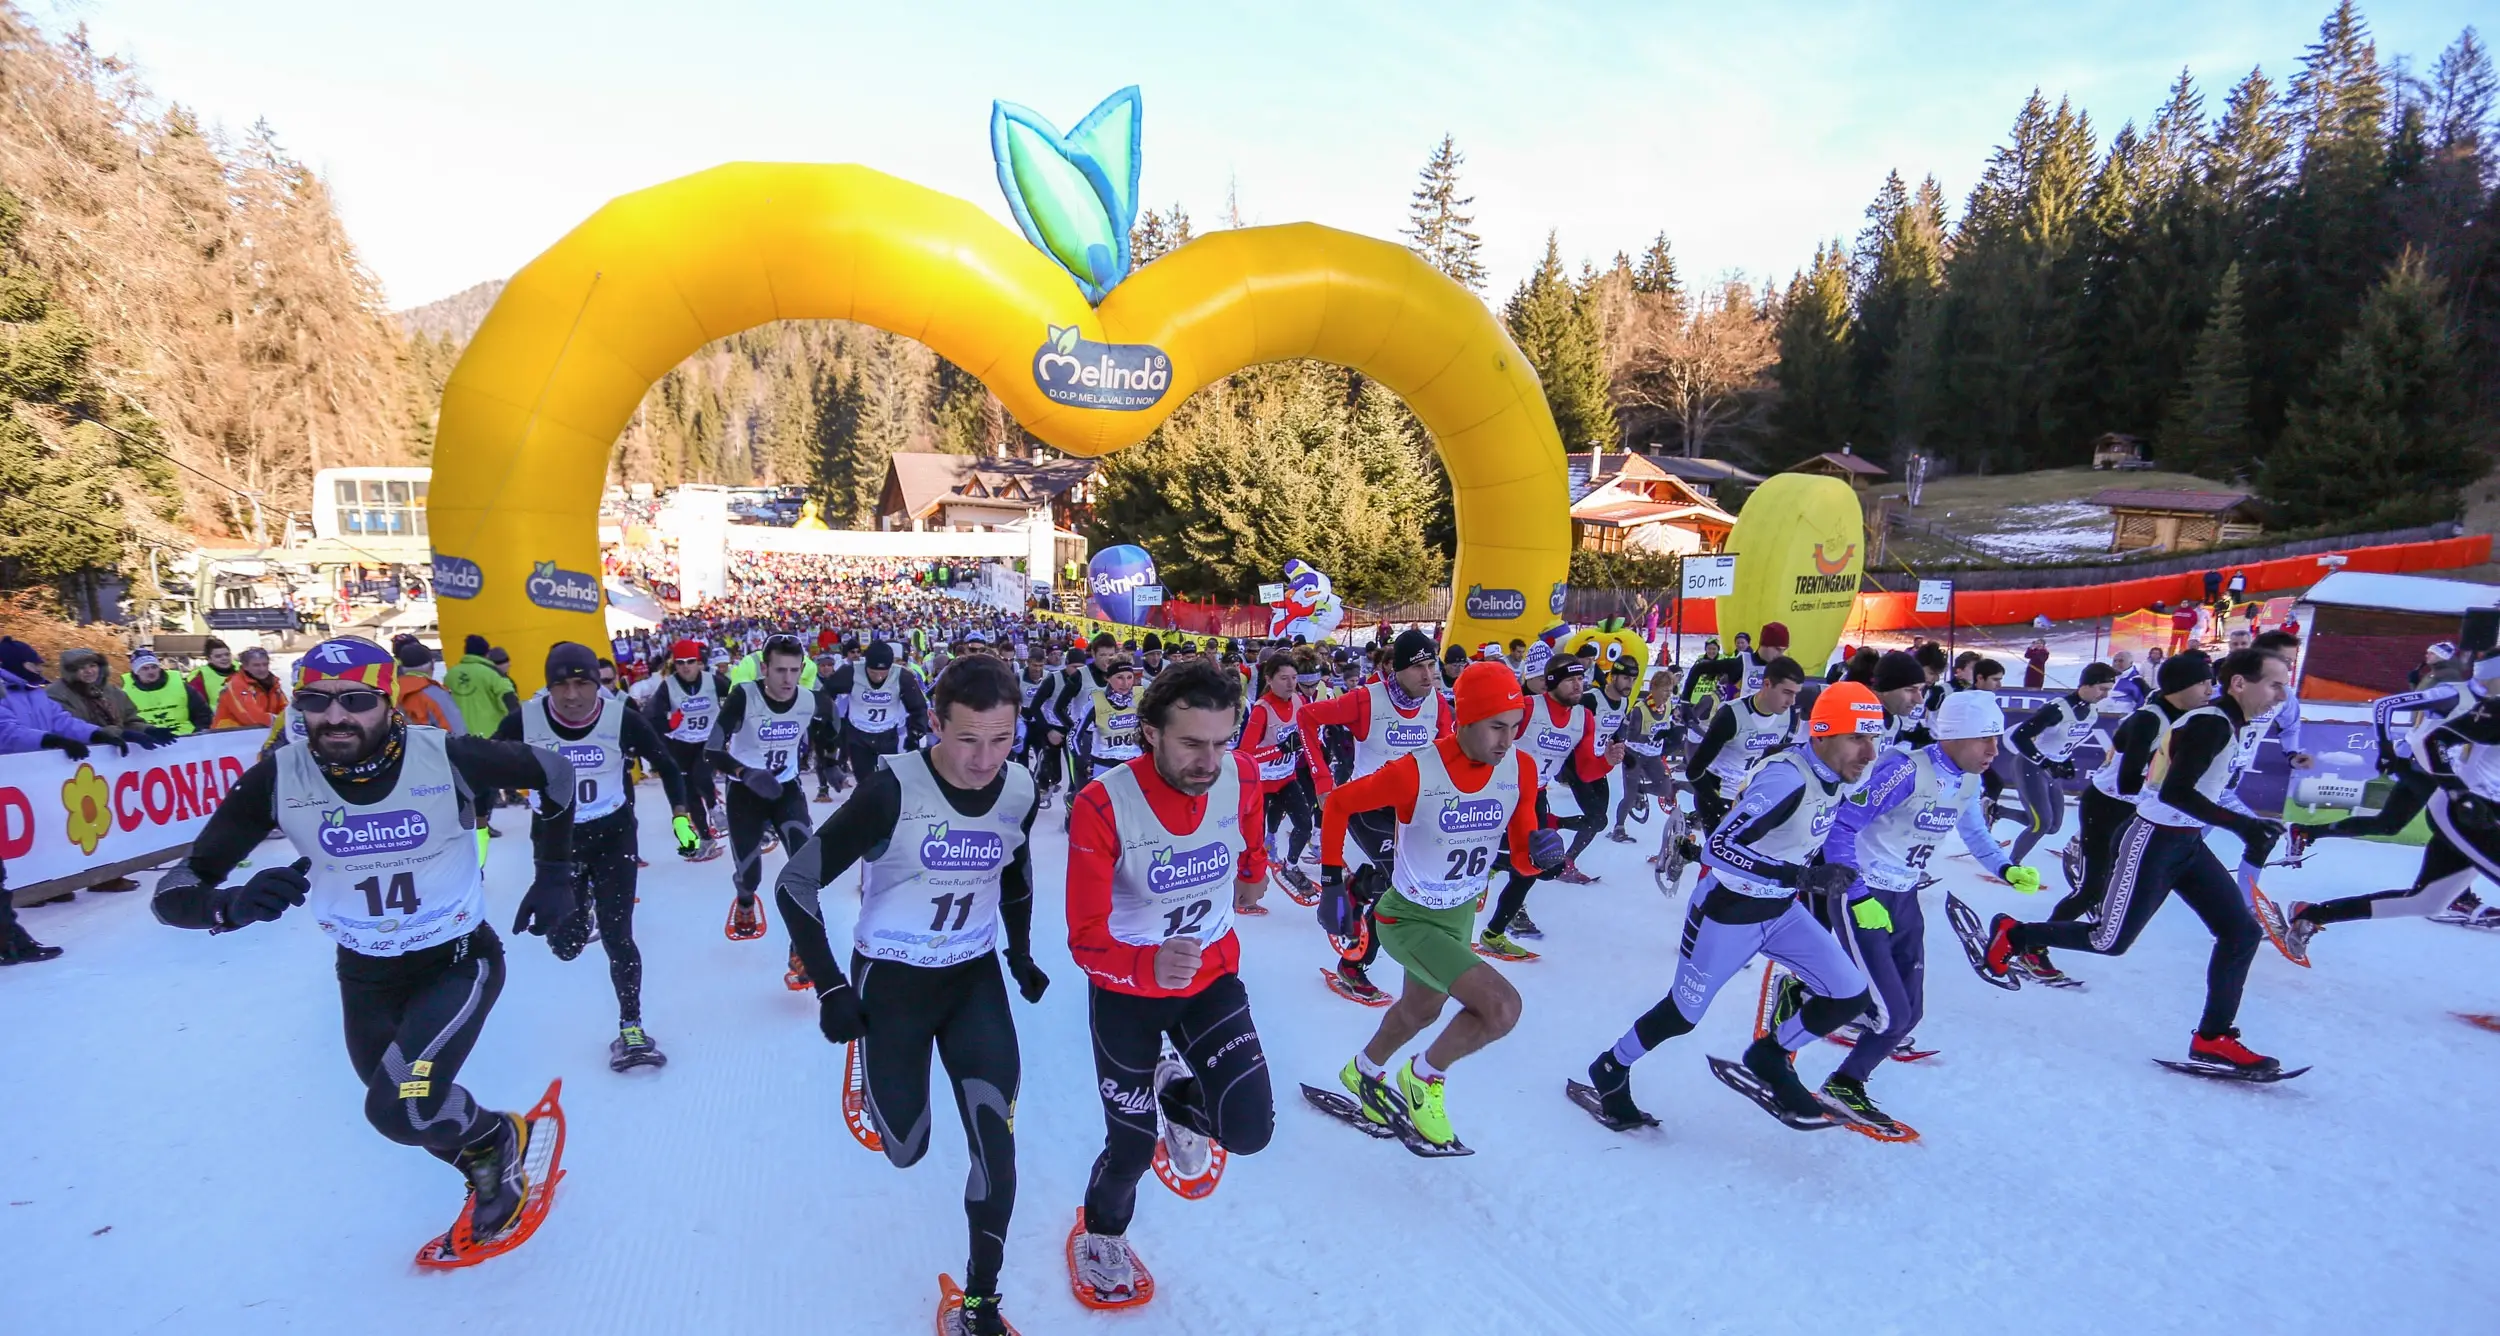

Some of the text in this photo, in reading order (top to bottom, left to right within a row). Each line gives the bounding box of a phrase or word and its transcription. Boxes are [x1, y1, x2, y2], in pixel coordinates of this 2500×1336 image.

[1125, 396, 1136, 405] DI
[1135, 396, 1155, 405] NON
[433, 565, 480, 589] elinda
[1089, 571, 1146, 596] TRENTINO
[1688, 574, 1727, 589] 50 mt.
[1794, 574, 1856, 595] TRENTINGRANA
[529, 577, 599, 604] Melinda
[1921, 593, 1933, 605] 50
[1466, 595, 1523, 610] Melinda
[687, 715, 709, 731] 59
[868, 708, 887, 723] 27
[760, 724, 799, 737] Melinda
[1386, 729, 1428, 741] Melinda
[564, 749, 603, 763] linda
[1441, 805, 1502, 825] Melinda
[321, 816, 427, 847] Melinda
[923, 838, 1001, 859] Melinda
[1905, 844, 1935, 869] 15
[344, 864, 375, 873] Casse
[375, 860, 404, 870] Rurali
[1150, 849, 1230, 885] Melinda
[1444, 846, 1488, 881] 26
[928, 877, 953, 886] Casse
[1207, 870, 1220, 880] NON
[354, 871, 422, 917] 14
[1160, 896, 1185, 905] Casse
[929, 892, 975, 932] 11
[1163, 899, 1212, 937] 12
[877, 947, 908, 959] 2015
[1683, 973, 1707, 993] TEAM
